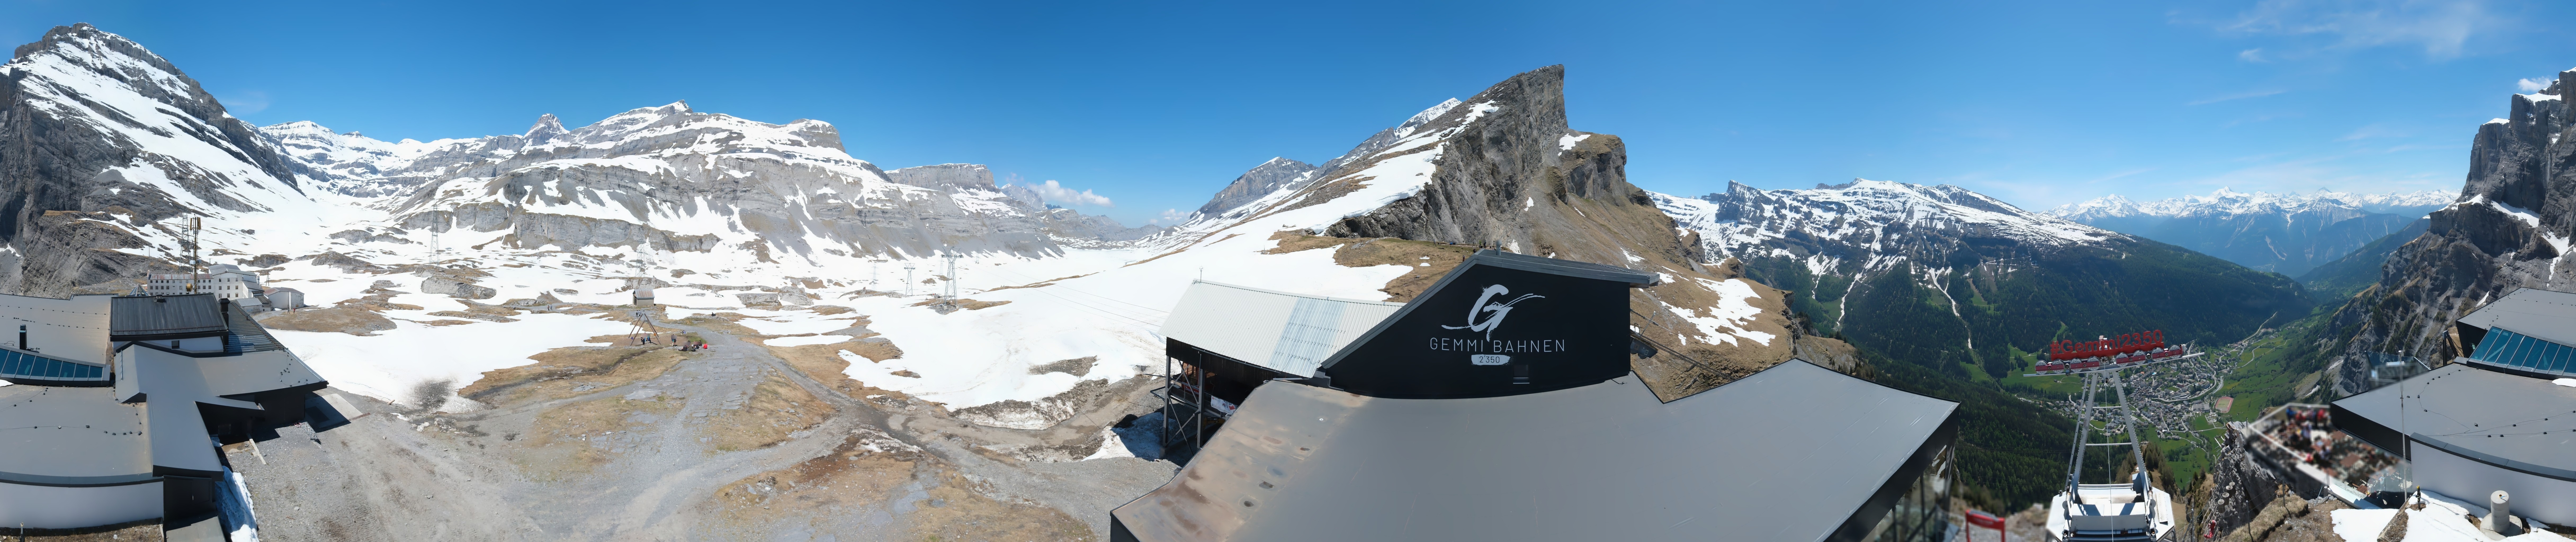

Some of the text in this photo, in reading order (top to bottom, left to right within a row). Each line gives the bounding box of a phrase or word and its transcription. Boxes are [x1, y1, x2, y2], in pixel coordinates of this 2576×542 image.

[1430, 337, 1564, 353] GEMMI BAHNEN
[2050, 330, 2163, 354] #Gemmi2350
